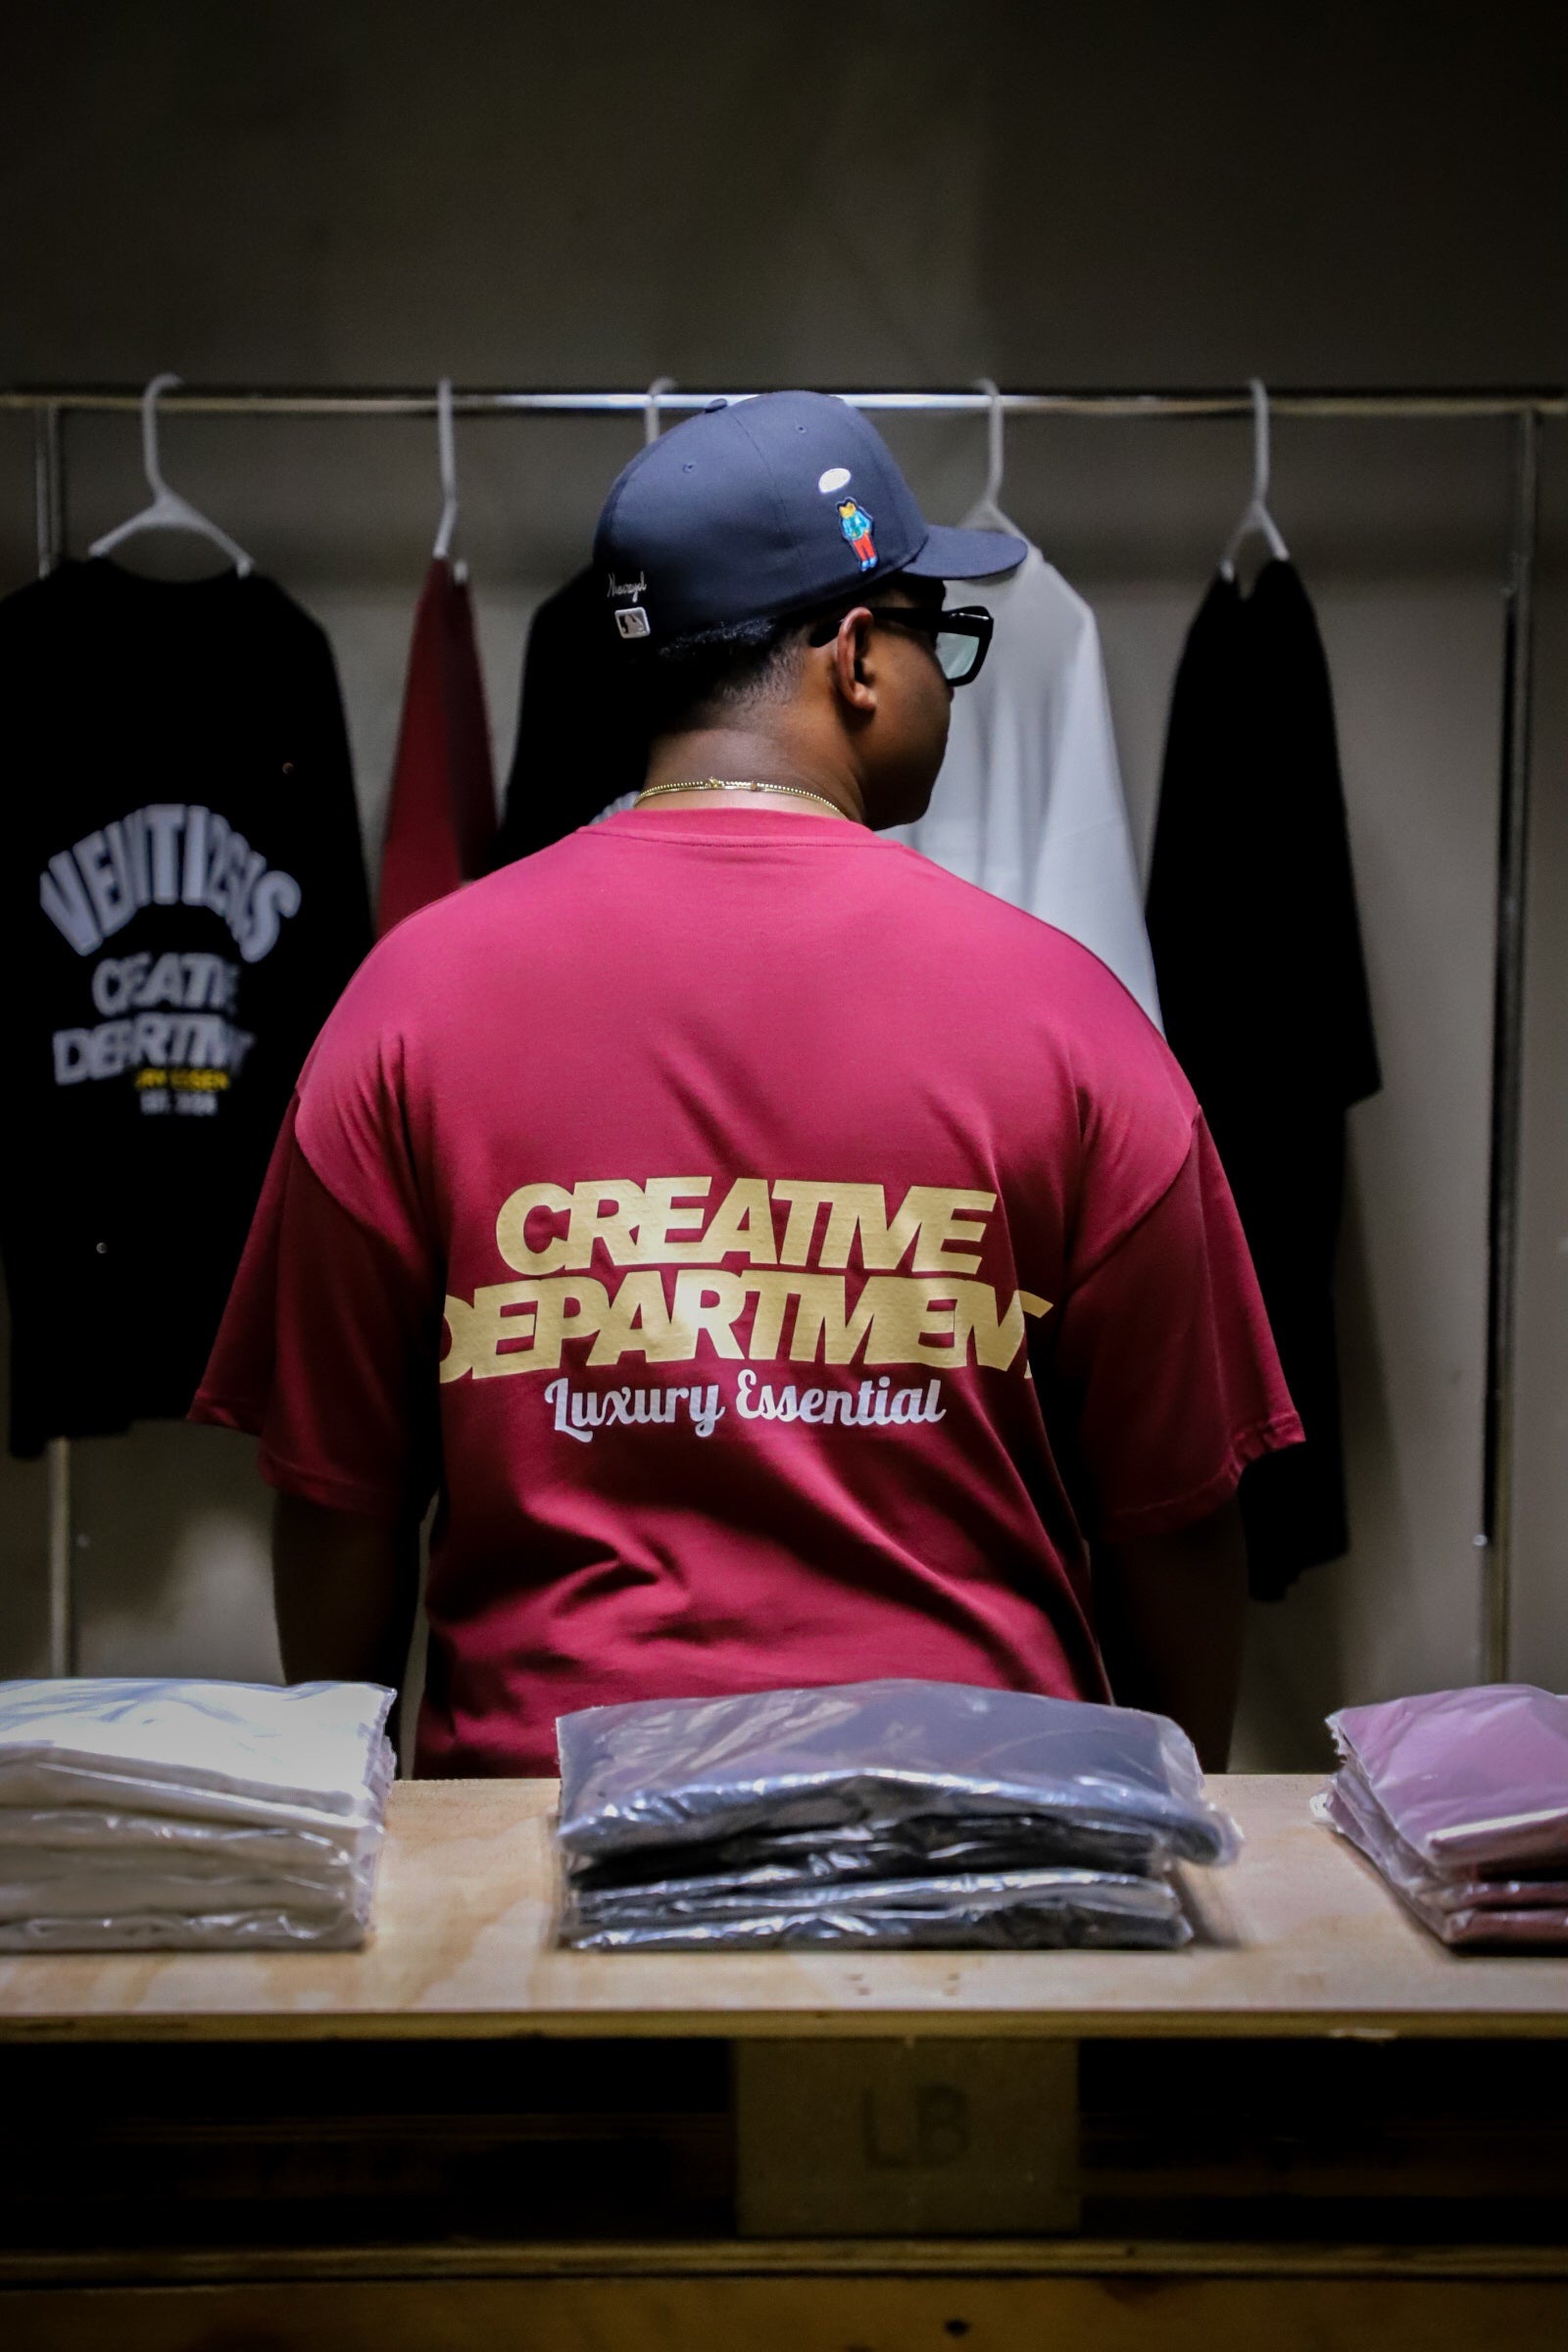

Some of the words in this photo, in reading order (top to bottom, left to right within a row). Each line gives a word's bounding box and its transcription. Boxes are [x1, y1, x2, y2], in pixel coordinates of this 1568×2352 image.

[495, 1176, 998, 1276] CREATIVE
[544, 1377, 725, 1443] Luxury
[735, 1368, 947, 1426] Essential
